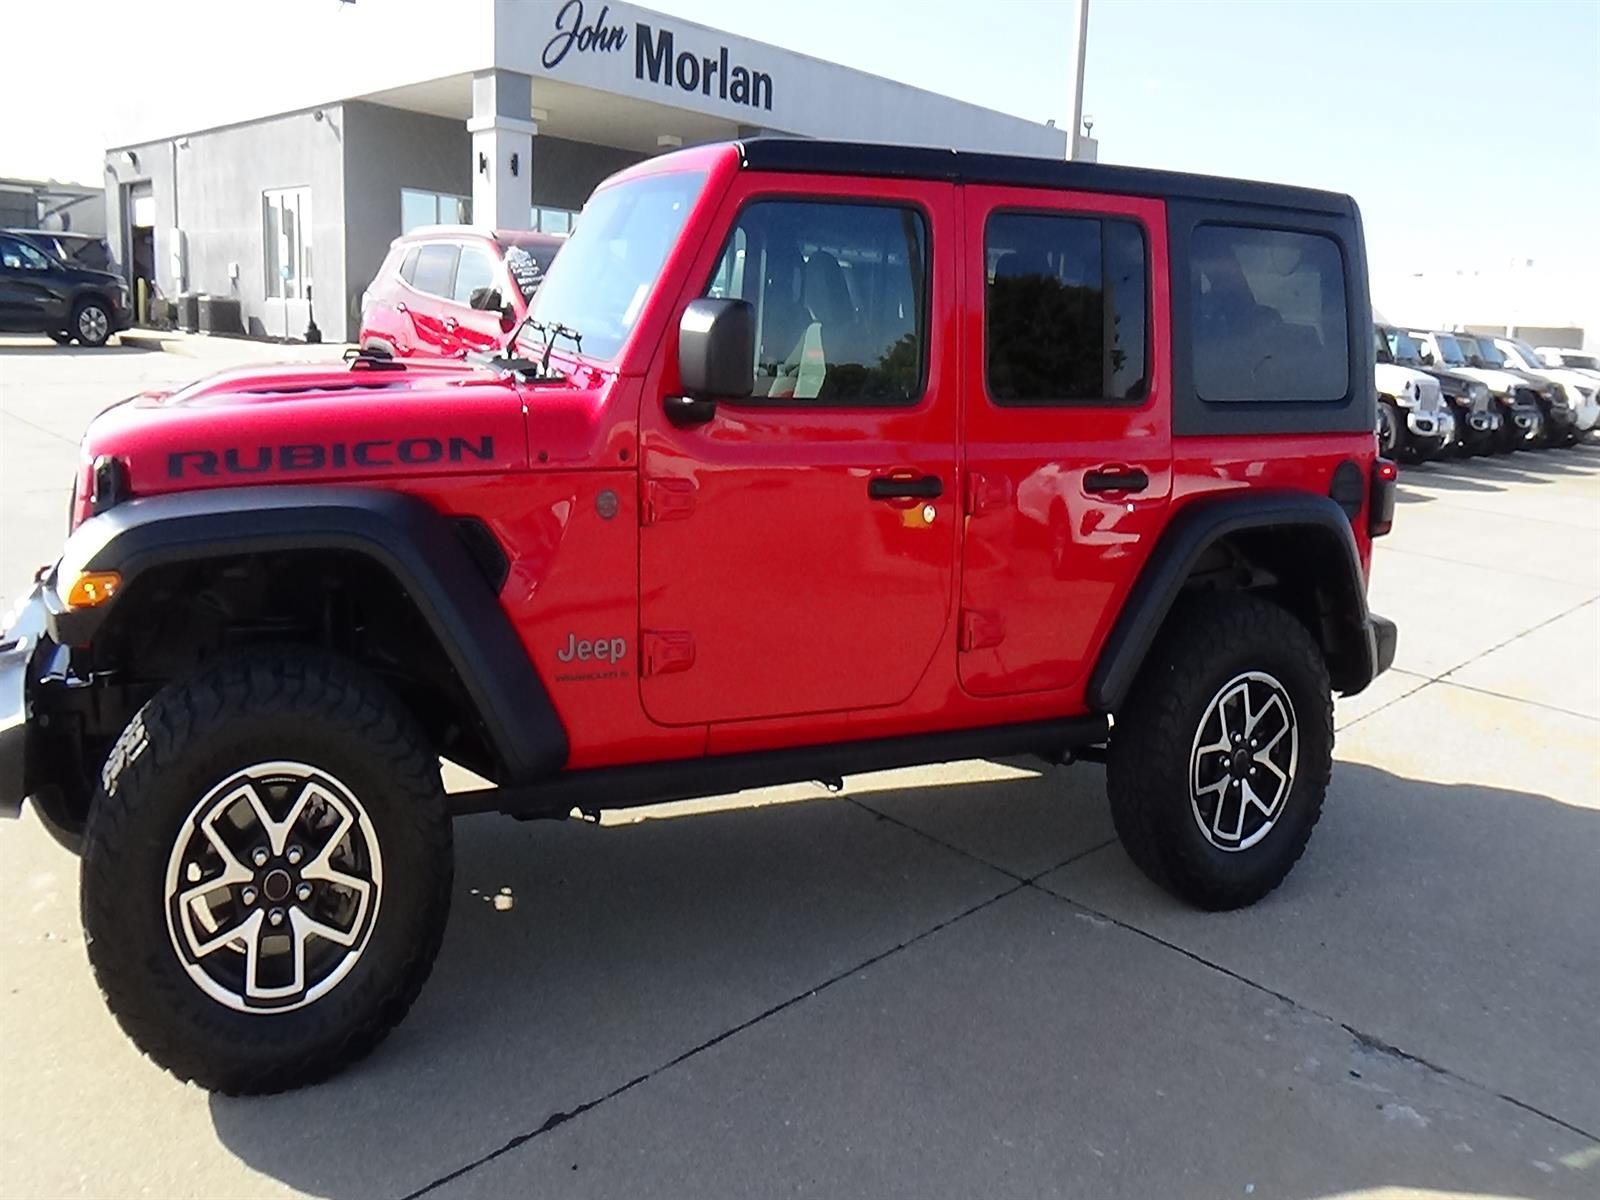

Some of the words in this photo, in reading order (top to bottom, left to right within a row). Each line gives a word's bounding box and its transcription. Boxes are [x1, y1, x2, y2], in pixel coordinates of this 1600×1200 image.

[542, 0, 628, 69] John
[635, 22, 774, 111] Morlan
[168, 435, 495, 479] RUBICON
[557, 632, 627, 664] Jeep
